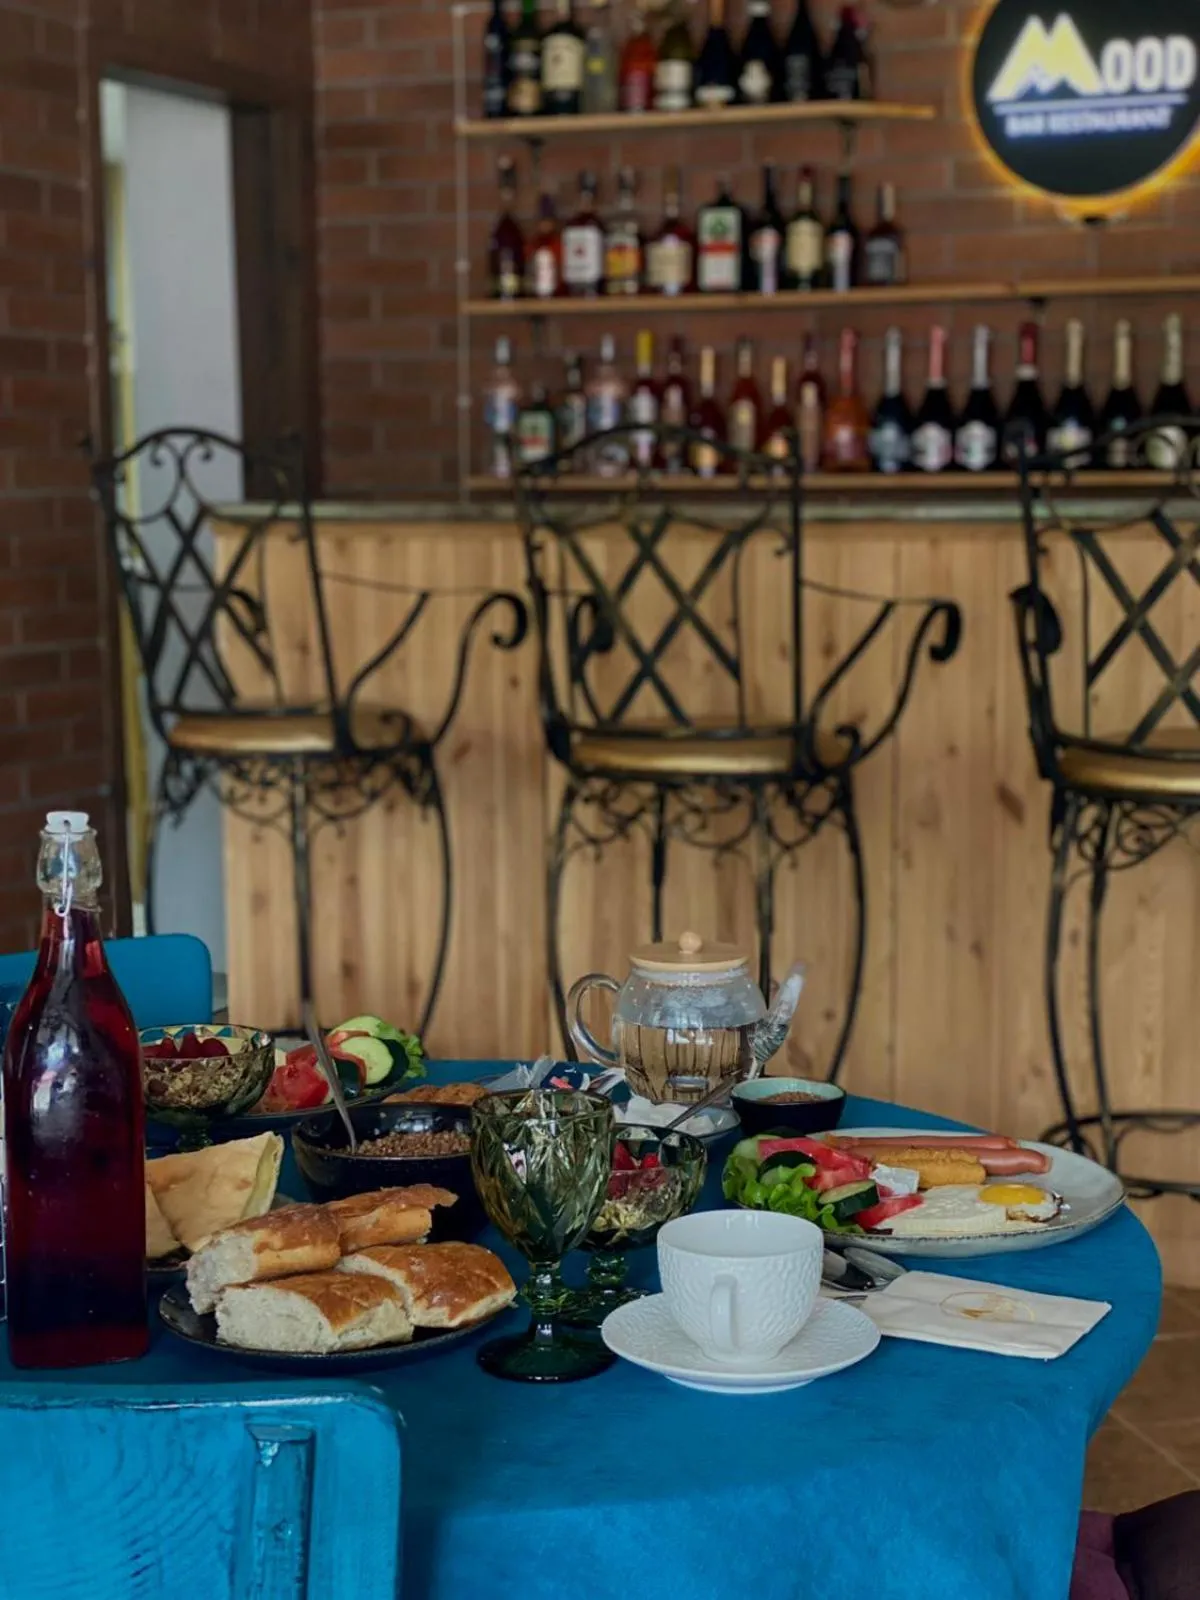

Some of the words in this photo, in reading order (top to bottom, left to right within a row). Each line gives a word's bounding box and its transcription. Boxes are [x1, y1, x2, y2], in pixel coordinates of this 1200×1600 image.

[988, 12, 1195, 102] MOOD
[1005, 114, 1044, 137] BAR
[1050, 106, 1172, 134] RESTAURANT
